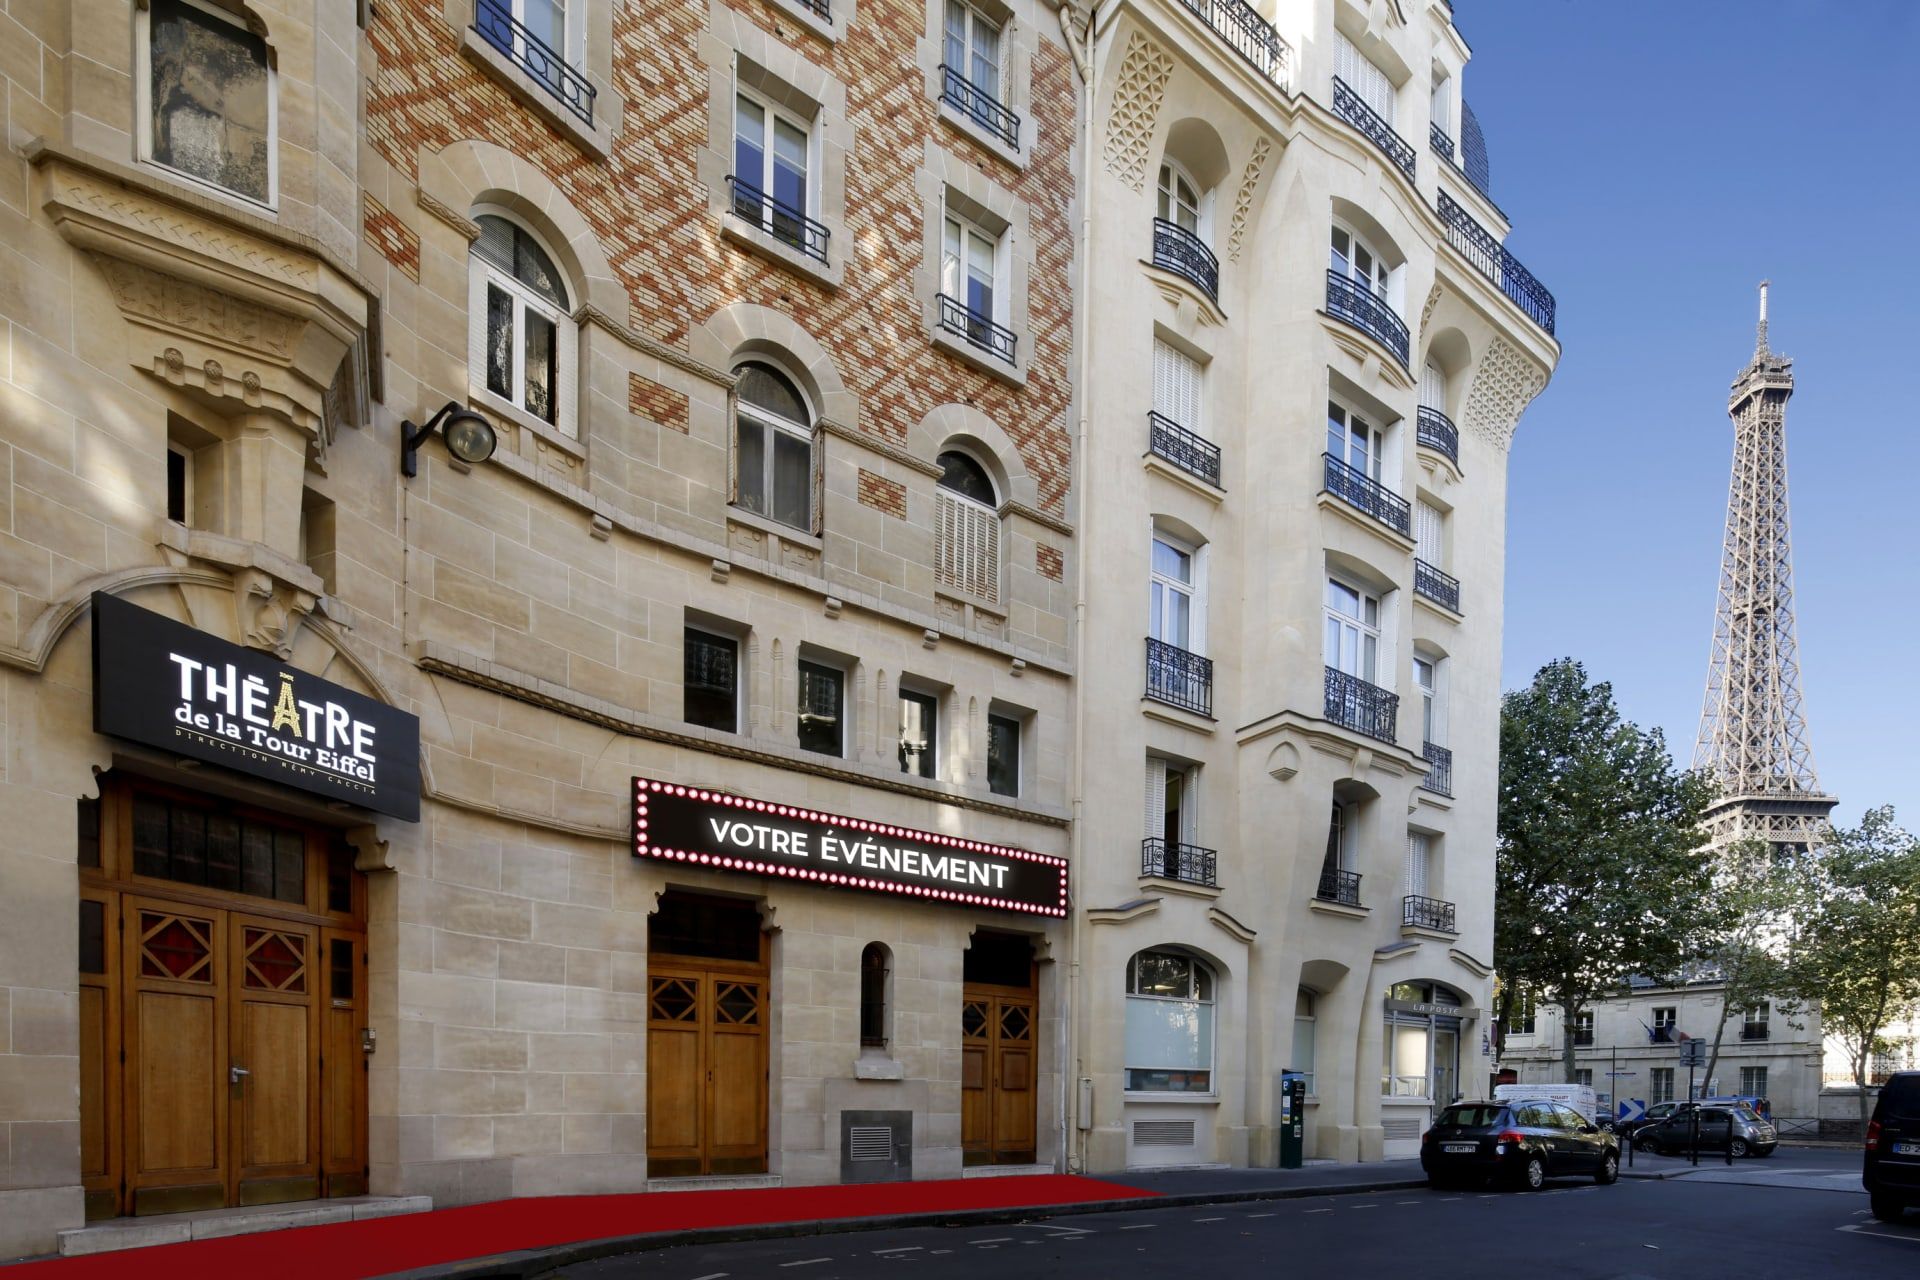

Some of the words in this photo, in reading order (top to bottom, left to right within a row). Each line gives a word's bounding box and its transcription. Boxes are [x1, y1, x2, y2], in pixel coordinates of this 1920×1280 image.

[174, 702, 210, 730] de
[215, 712, 242, 740] la
[246, 725, 311, 761] Tour
[315, 747, 376, 783] Eiffel
[175, 729, 268, 763] DIRECTION
[327, 775, 376, 796] CACCIA
[710, 818, 808, 856] VOTRE
[821, 830, 1009, 888] ÉVÉNEMENT
[1413, 1003, 1425, 1012] LA
[1430, 1005, 1460, 1015] POSTE
